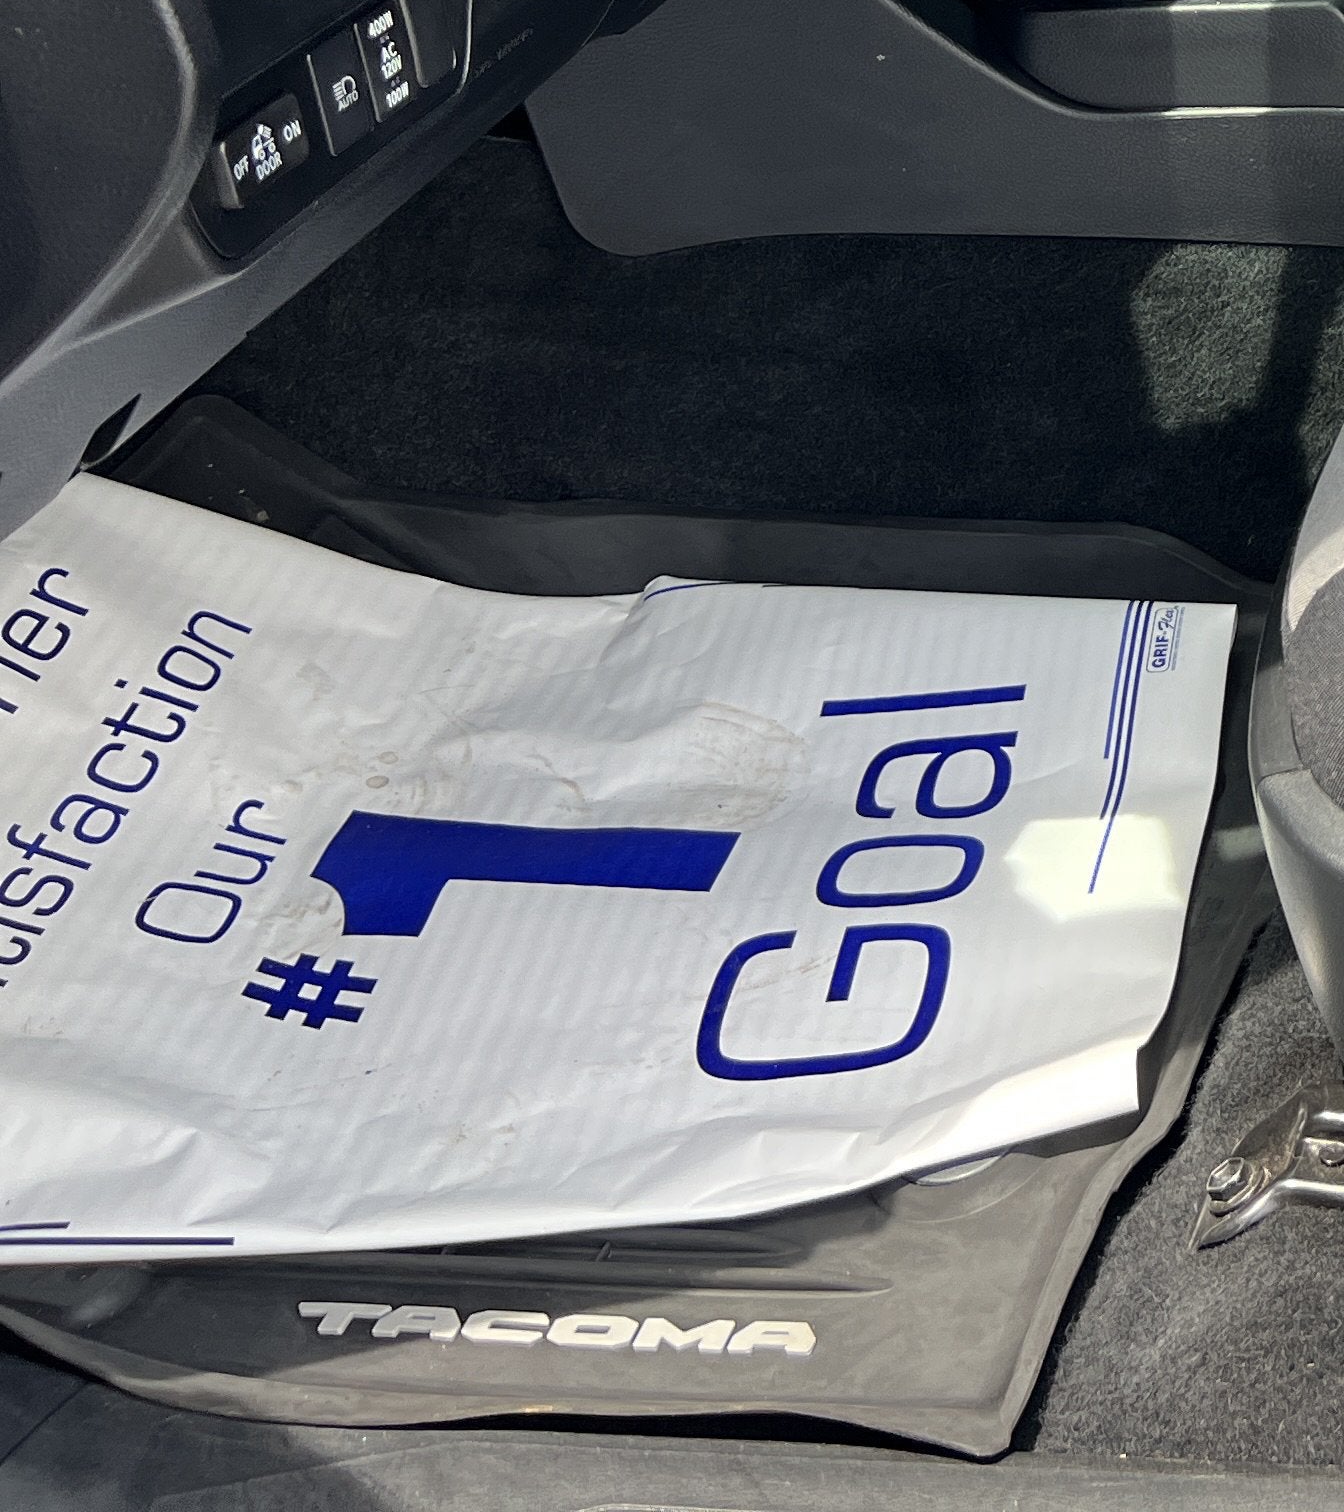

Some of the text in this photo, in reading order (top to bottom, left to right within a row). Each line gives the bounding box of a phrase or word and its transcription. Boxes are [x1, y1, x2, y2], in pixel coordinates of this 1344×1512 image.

[367, 10, 394, 38] 400W
[381, 41, 398, 64] AC
[381, 54, 402, 80] 120V
[338, 89, 359, 112] AUTO
[386, 81, 410, 108] 100W
[233, 119, 301, 181] OFF ON
[255, 150, 283, 181] DOOR
[135, 799, 287, 944] Our
[696, 684, 1027, 1081] Goal
[242, 809, 741, 1030] #1
[298, 1300, 818, 1356] TACOMA
